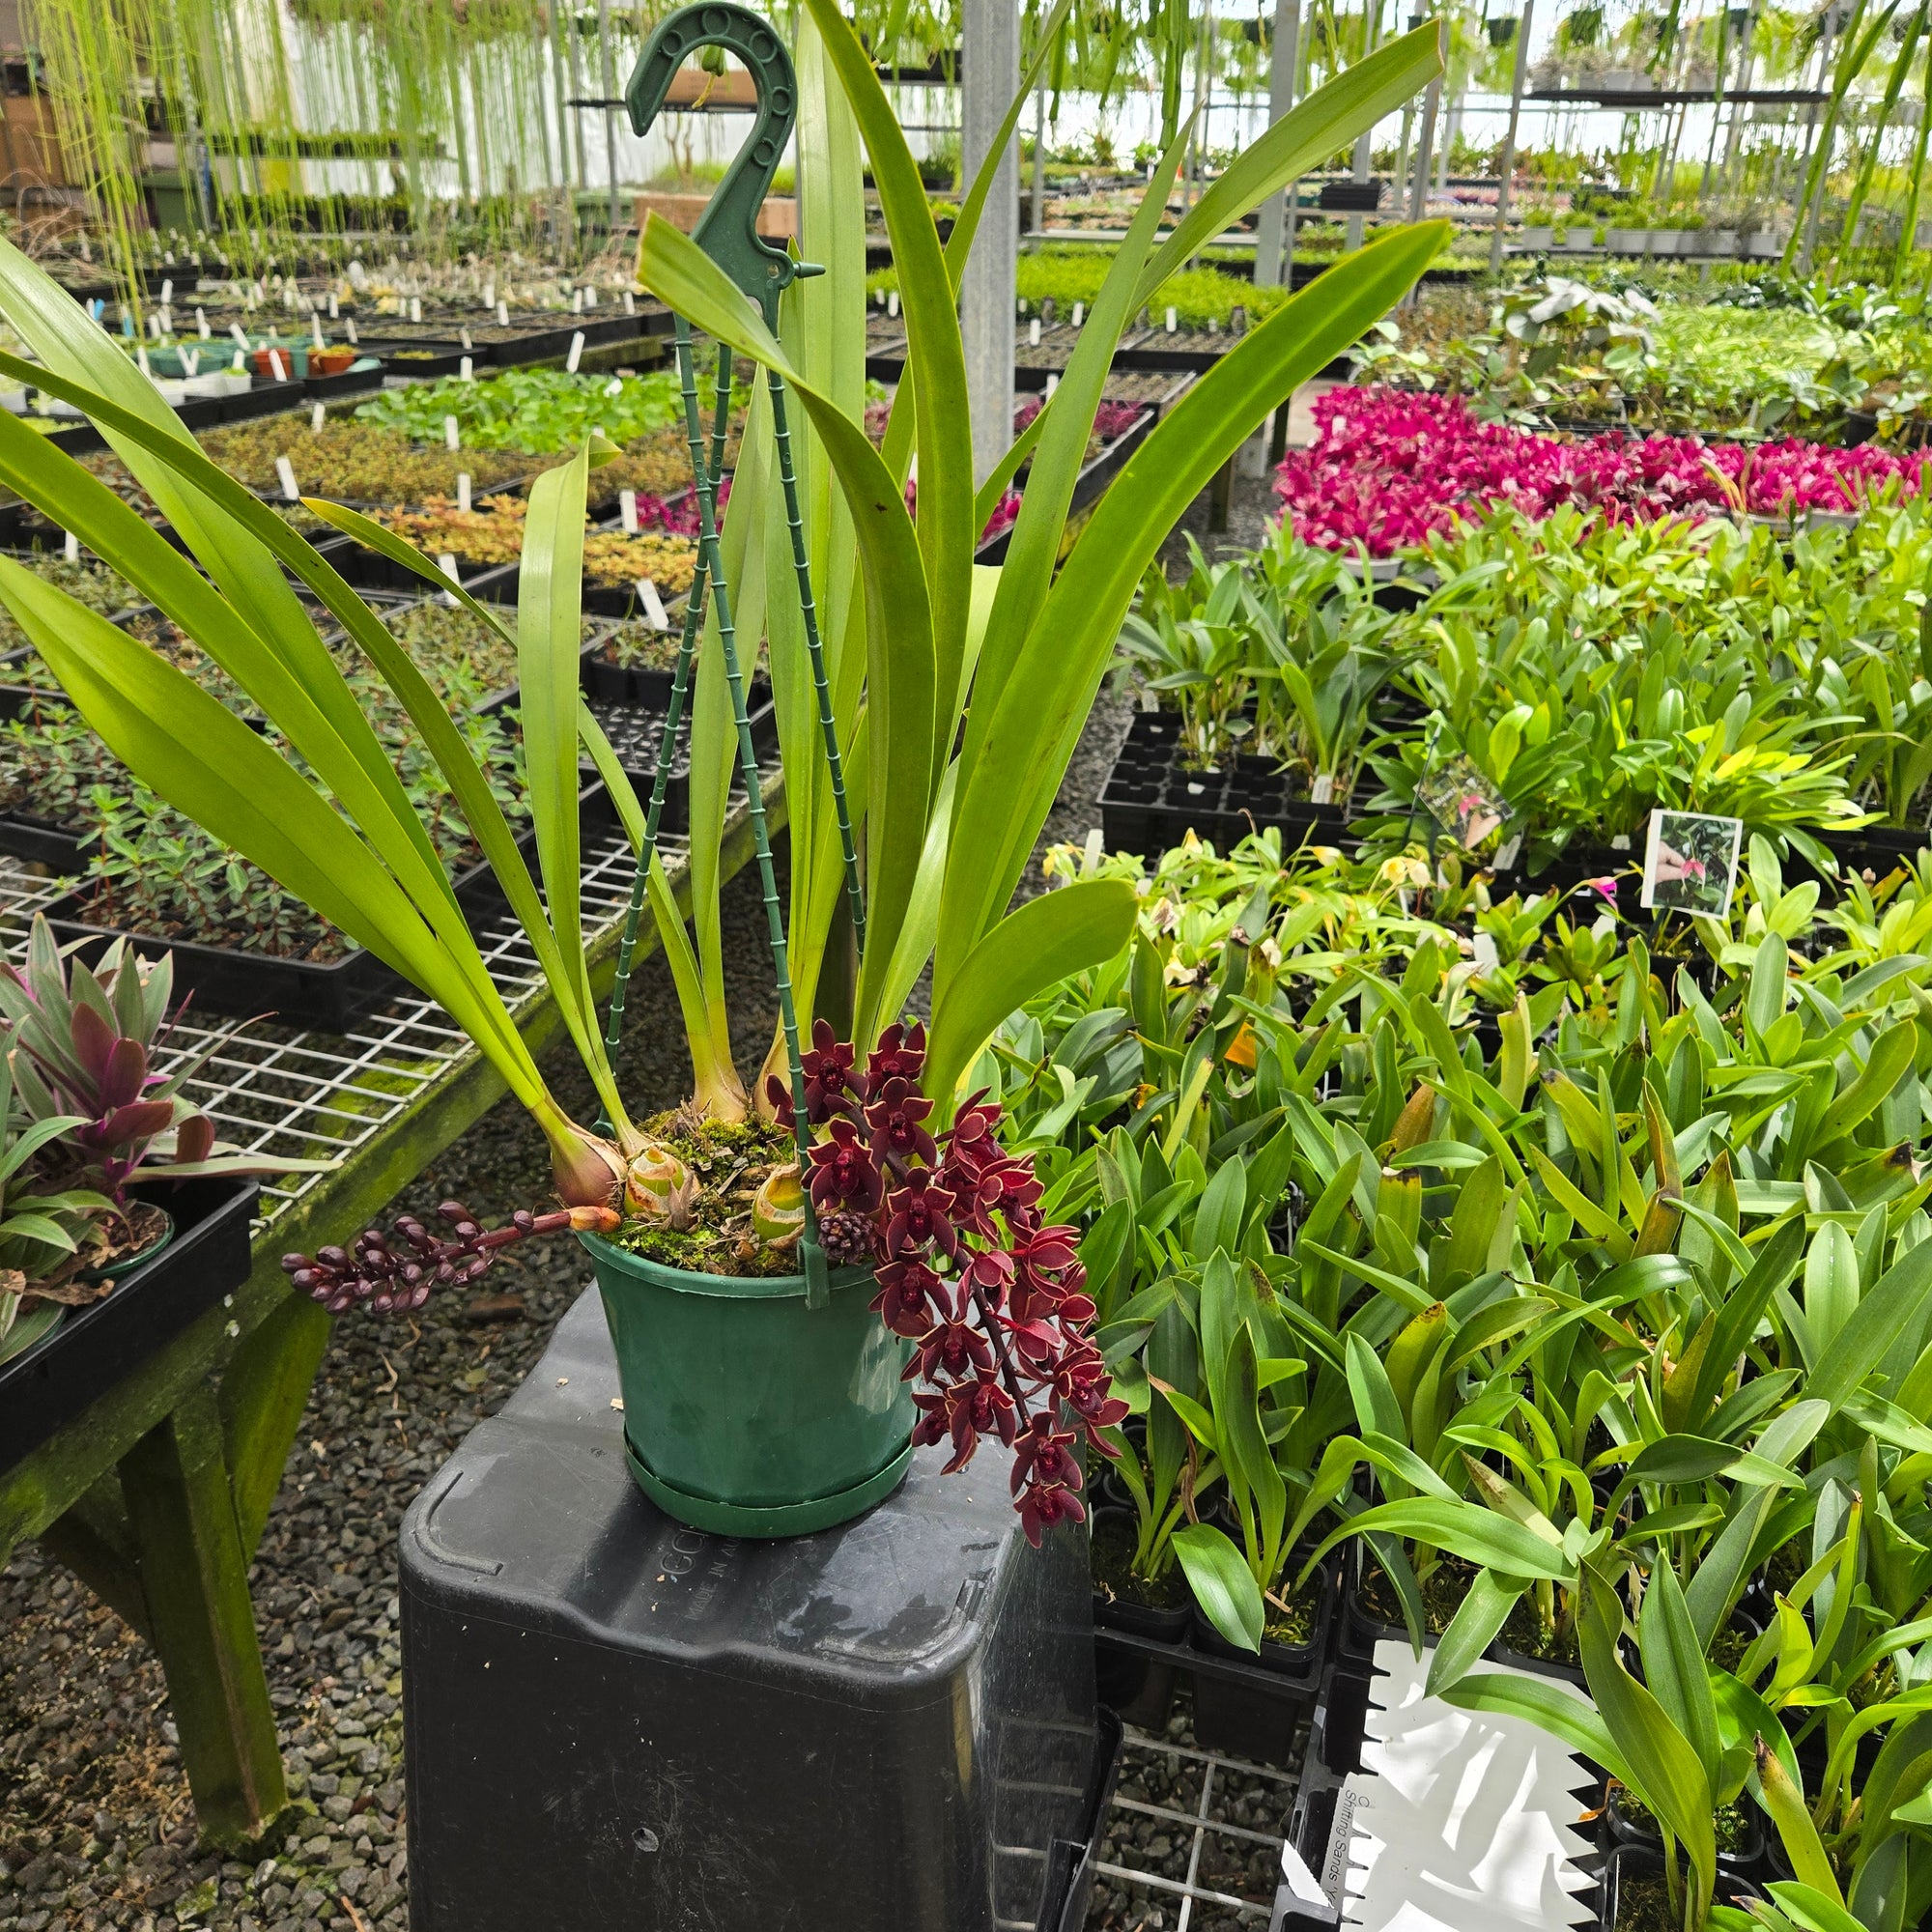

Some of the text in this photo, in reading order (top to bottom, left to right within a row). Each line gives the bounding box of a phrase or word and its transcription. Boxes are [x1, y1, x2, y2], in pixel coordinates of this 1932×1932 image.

[708, 1561, 727, 1577] IN
[1335, 1789, 1357, 1837] Shifting
[1328, 1839, 1347, 1882] Sands
